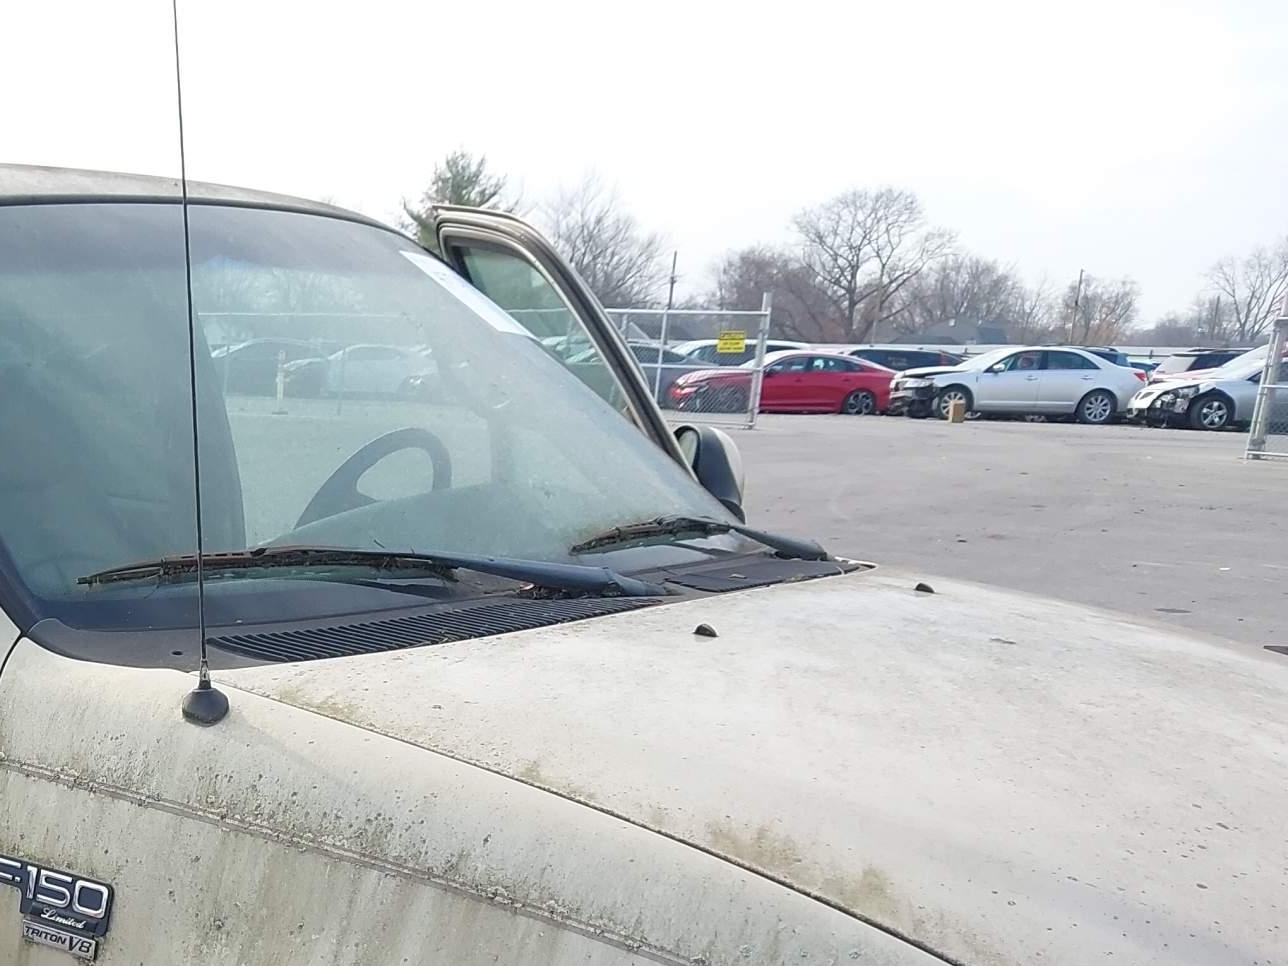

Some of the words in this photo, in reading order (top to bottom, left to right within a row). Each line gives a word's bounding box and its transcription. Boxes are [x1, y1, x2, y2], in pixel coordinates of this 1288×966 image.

[39, 906, 86, 930] Limited
[24, 924, 68, 946] TRITON
[67, 935, 93, 954] V8
